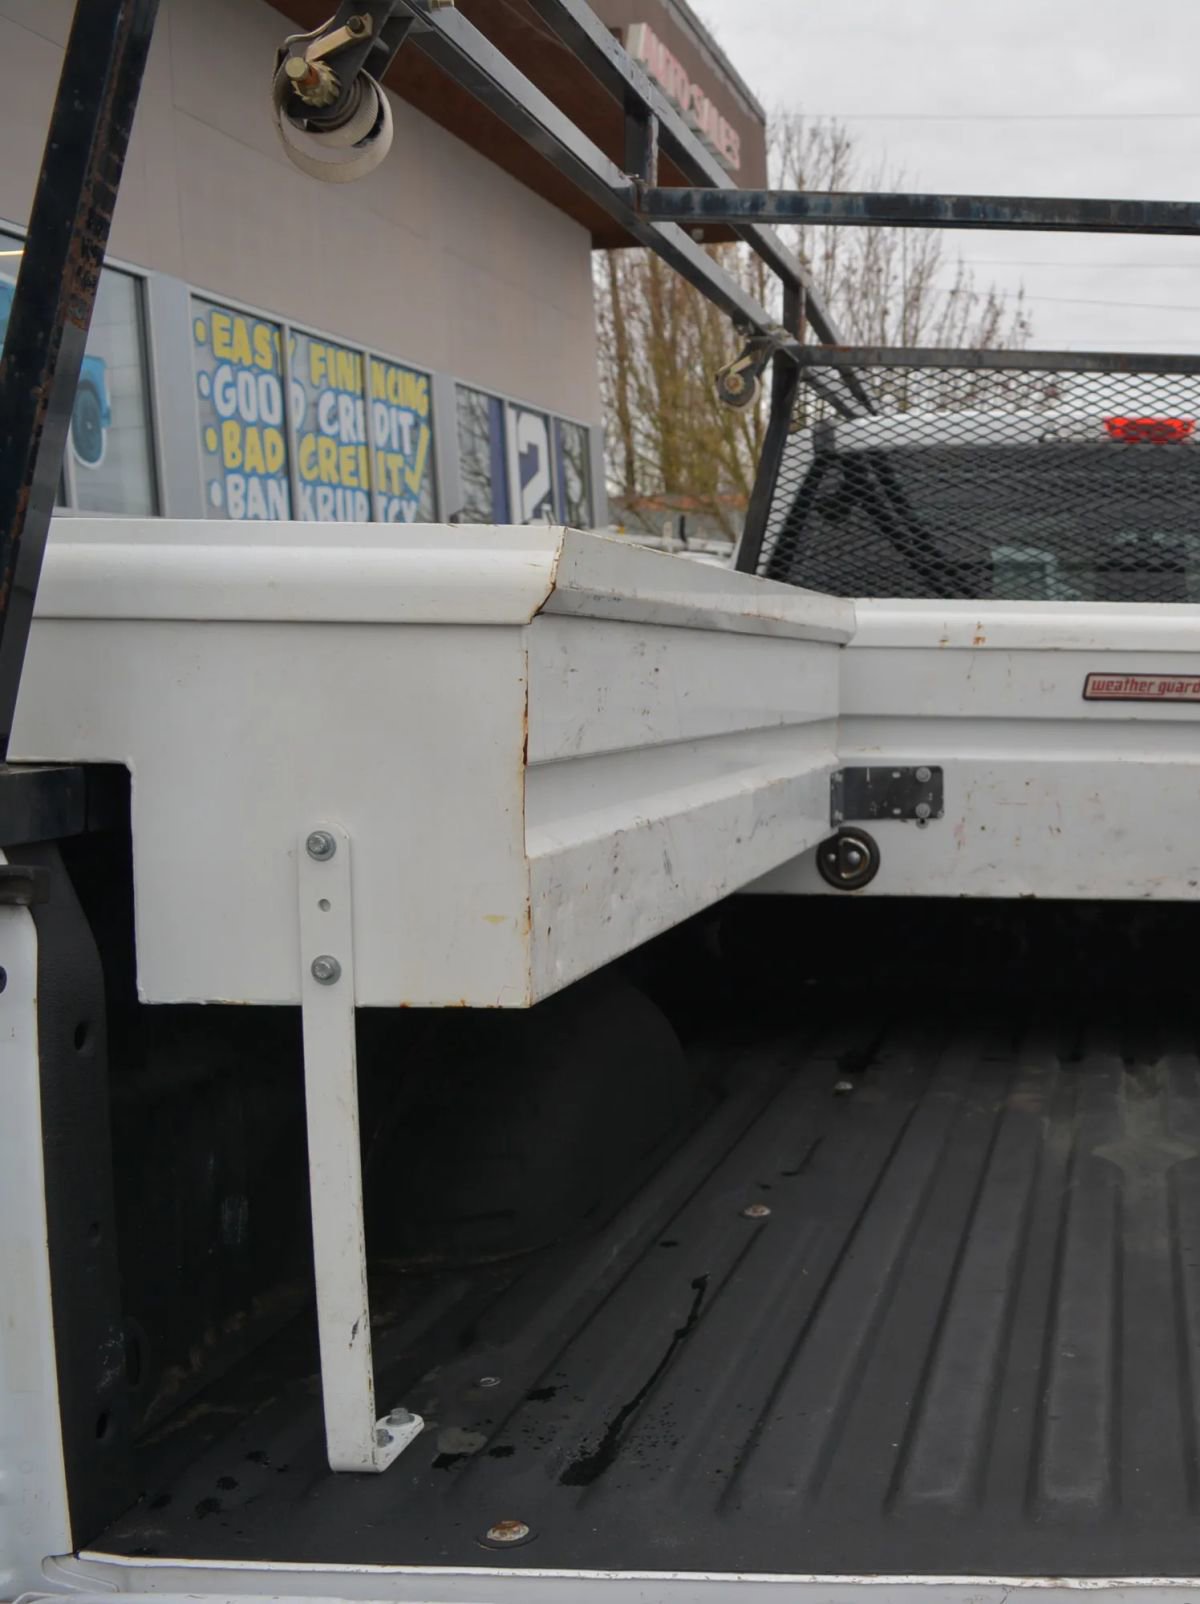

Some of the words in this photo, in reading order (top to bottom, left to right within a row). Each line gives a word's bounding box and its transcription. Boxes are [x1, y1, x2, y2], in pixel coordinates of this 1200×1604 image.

[211, 311, 296, 377] EASY
[214, 364, 305, 429] GOOD
[222, 419, 285, 474] BAD
[1091, 678, 1156, 693] weather
